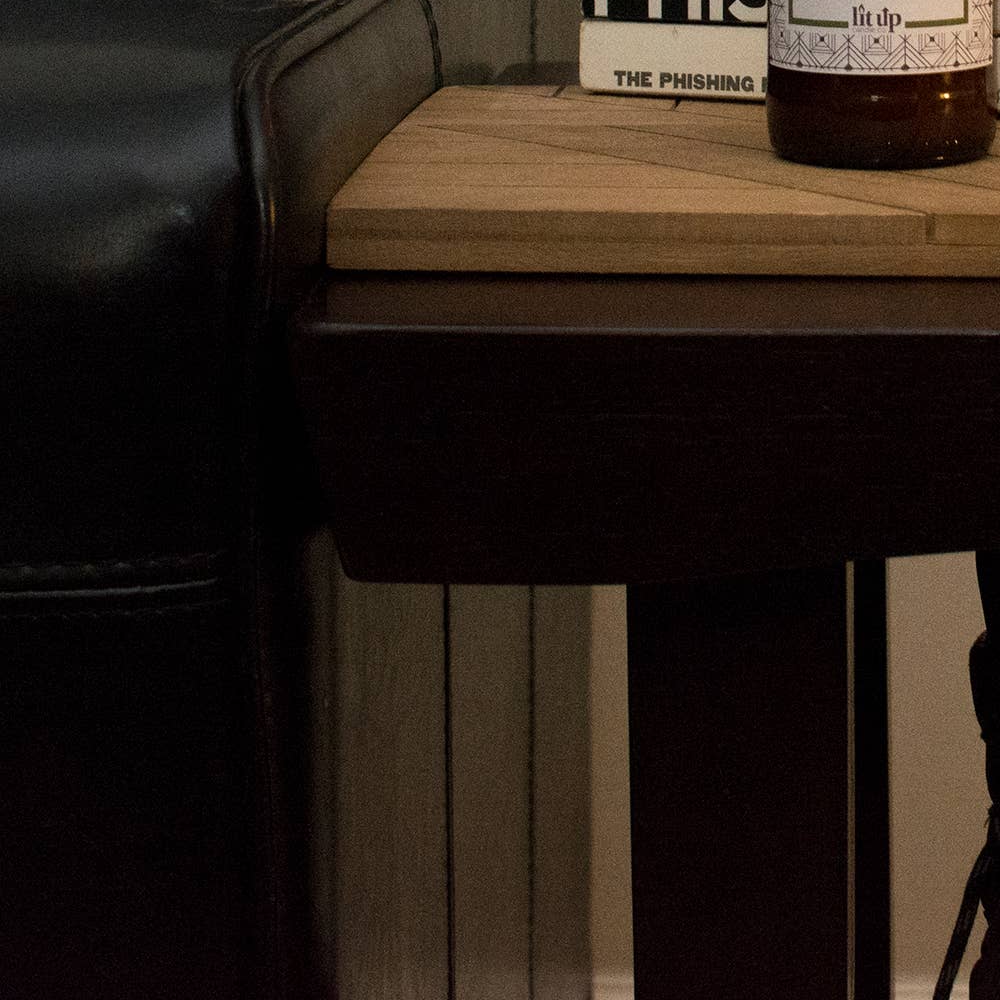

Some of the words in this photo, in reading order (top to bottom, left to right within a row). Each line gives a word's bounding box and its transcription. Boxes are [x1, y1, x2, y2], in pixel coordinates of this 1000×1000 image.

[852, 3, 872, 27] lit
[877, 7, 902, 32] up
[613, 70, 652, 88] THE
[659, 72, 755, 93] PHISHING
